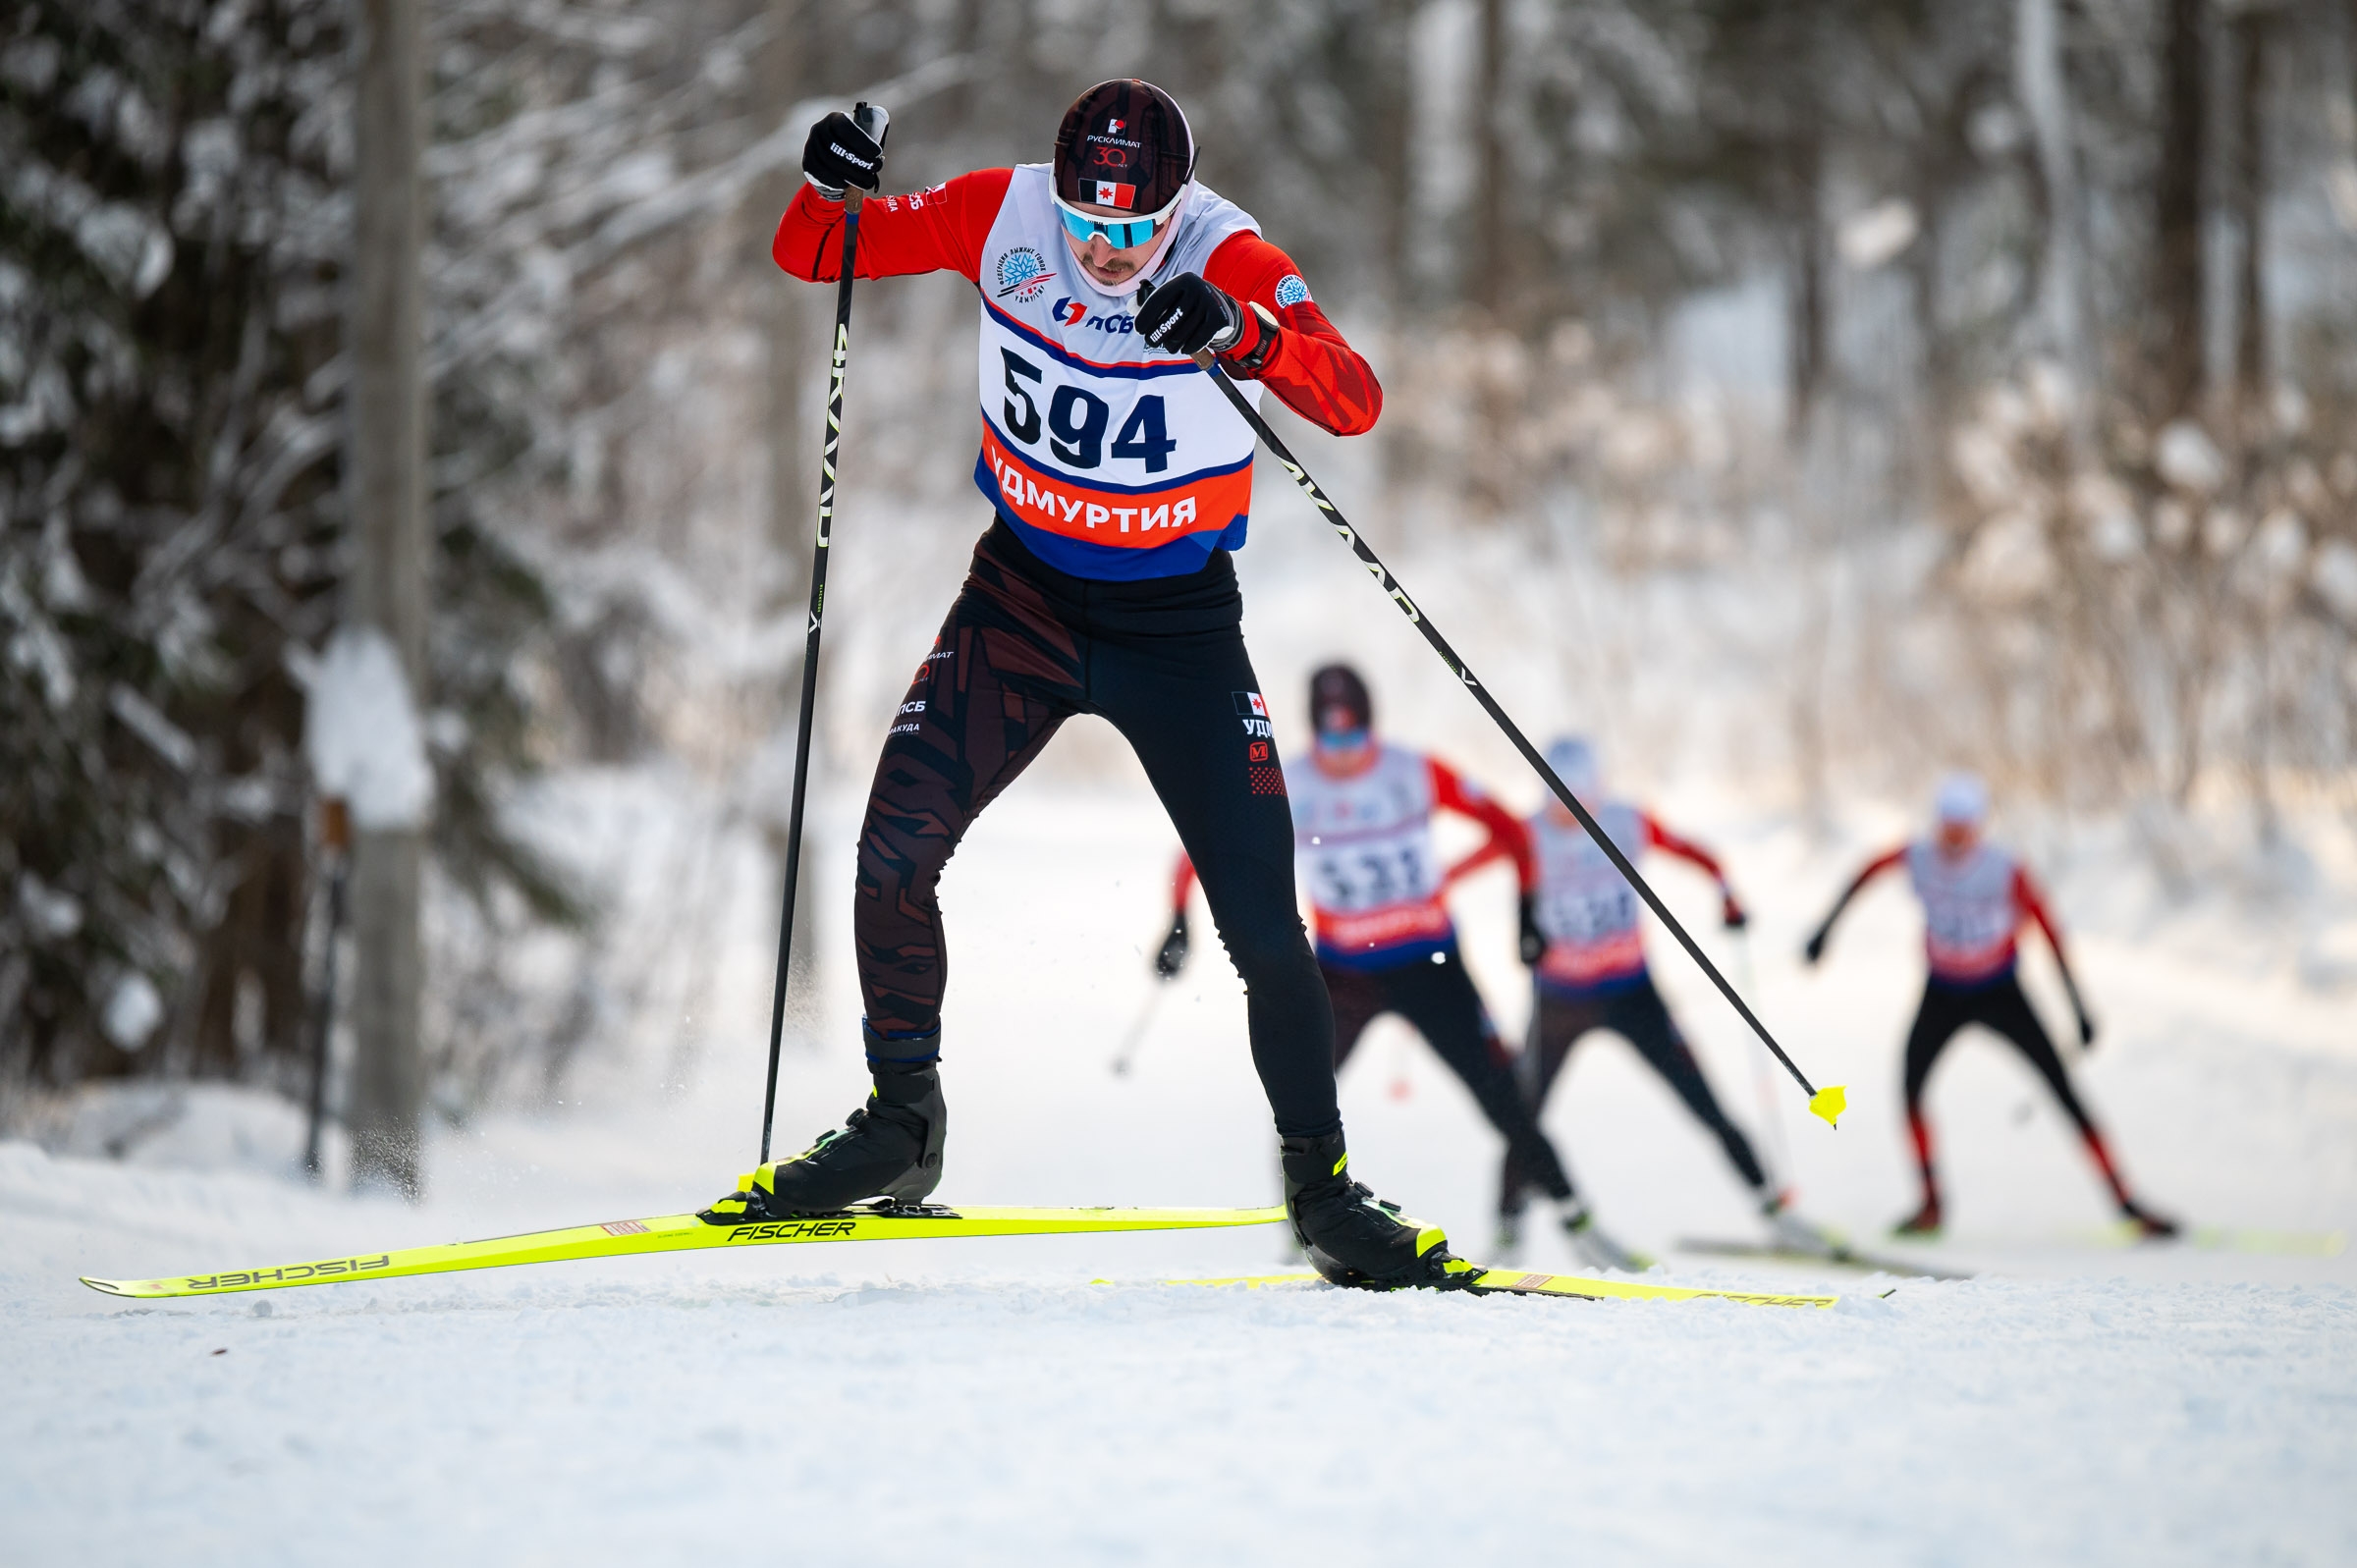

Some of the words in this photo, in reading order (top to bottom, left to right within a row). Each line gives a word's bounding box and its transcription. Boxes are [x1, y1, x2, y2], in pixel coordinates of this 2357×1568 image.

[1086, 135, 1142, 148] РУСКЛИМАТ
[1093, 146, 1126, 168] 30
[1000, 346, 1177, 474] 594
[991, 445, 1196, 533] УДМУРТИЯ
[727, 1221, 856, 1242] FISCHER
[188, 1255, 389, 1289] FISCHER
